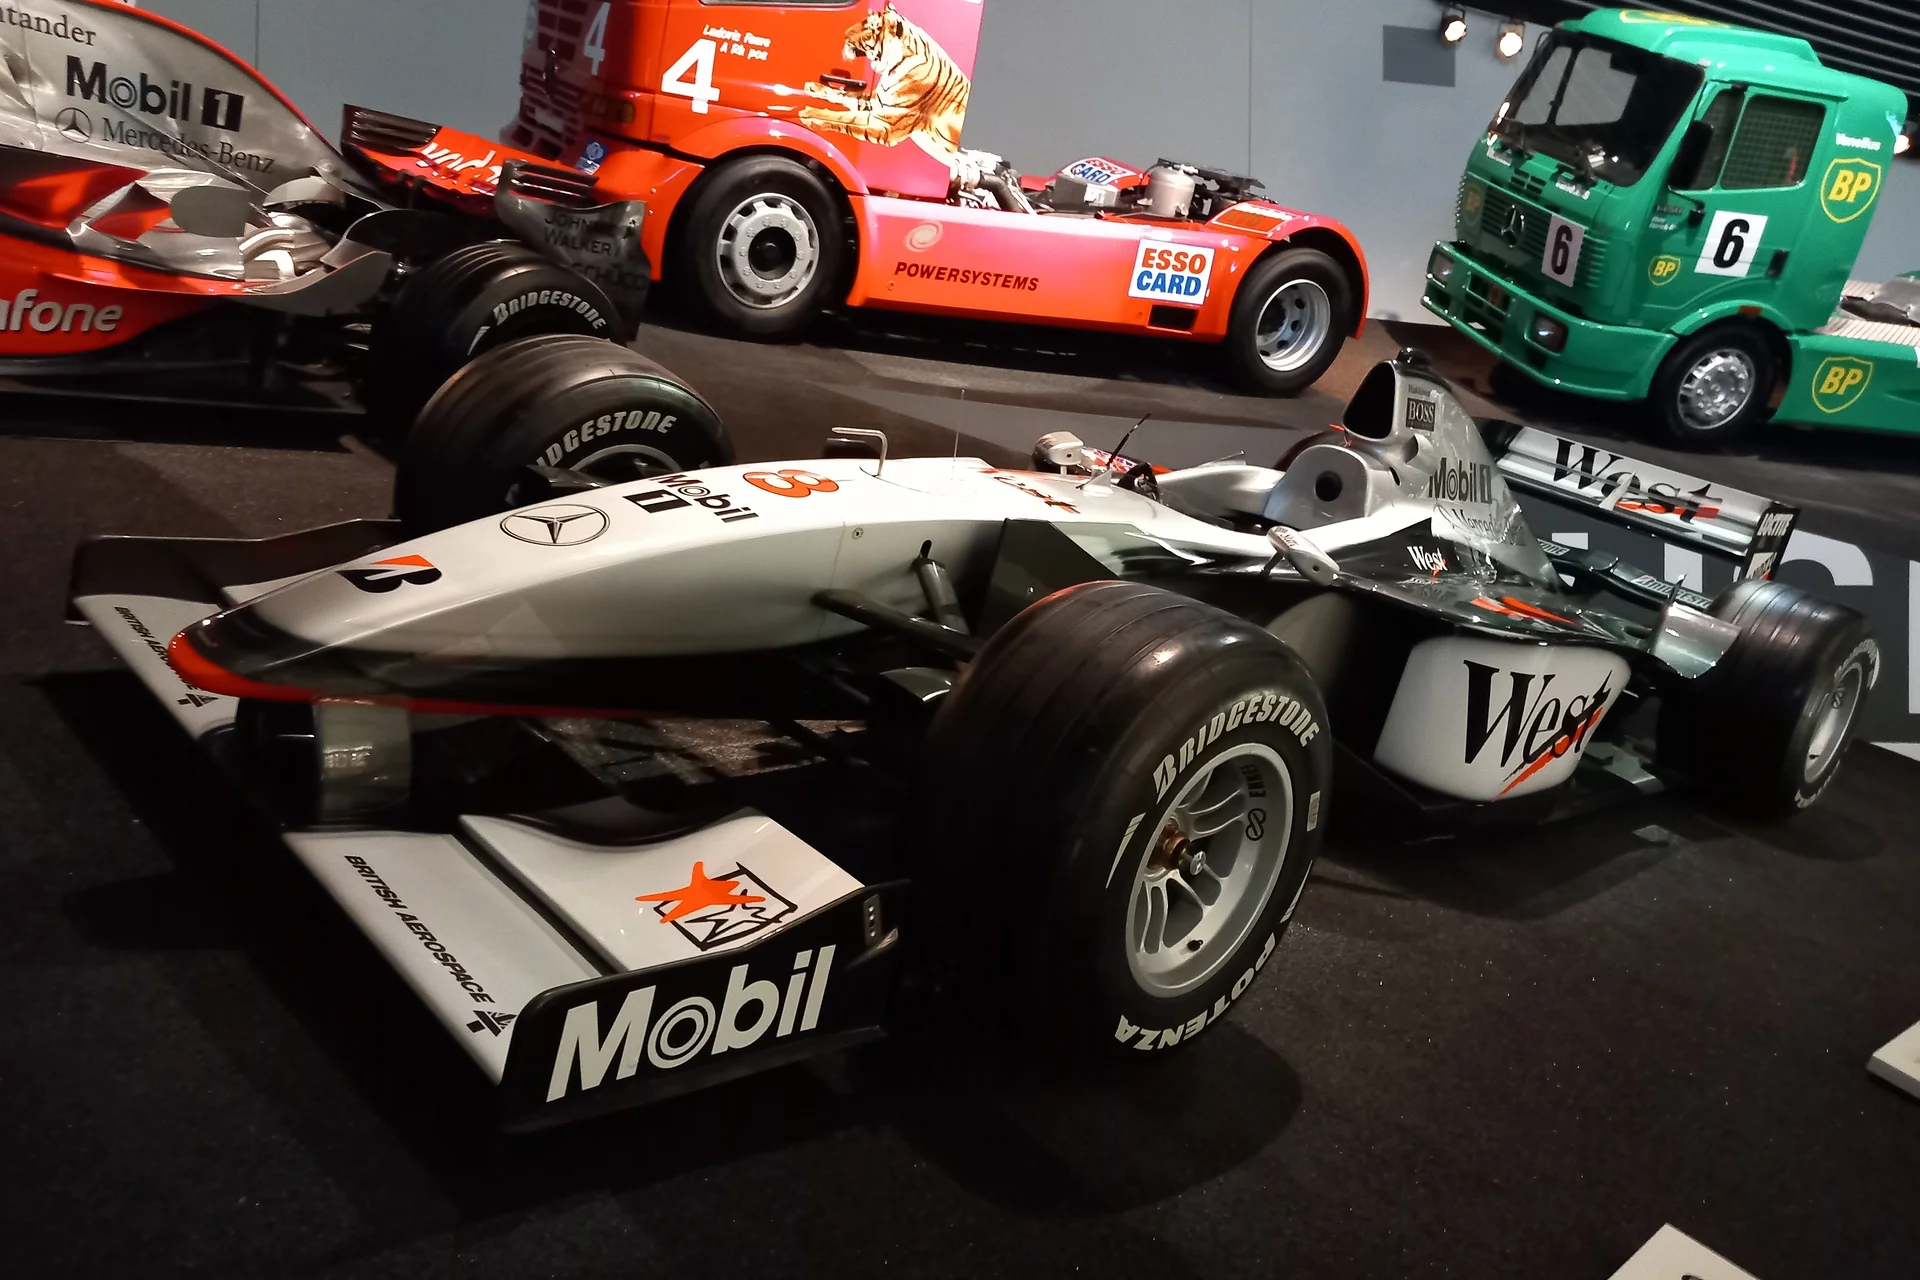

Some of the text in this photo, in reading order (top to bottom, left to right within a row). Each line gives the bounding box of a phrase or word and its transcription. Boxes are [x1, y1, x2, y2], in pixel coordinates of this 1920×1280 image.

[583, 2, 611, 76] 4
[66, 55, 191, 121] Mobil
[661, 38, 720, 115] 4
[103, 117, 275, 173] Mercedes-Benz
[1828, 169, 1872, 203] BP
[1142, 248, 1206, 274] ESSO
[1551, 224, 1573, 276] 6
[1653, 260, 1676, 277] BP
[1713, 218, 1750, 269] 6
[894, 261, 1040, 292] POWERSYSTEMS
[1137, 270, 1202, 296] CARD
[493, 290, 607, 331] BRIDGESTONE
[1819, 366, 1863, 395] BP
[1408, 400, 1434, 424] BOSS
[649, 474, 759, 523] Mobil
[743, 469, 839, 498] 8
[1429, 457, 1477, 503] Mobil
[1553, 438, 1723, 525] West
[1407, 546, 1448, 571] West
[1463, 660, 1613, 771] West
[1153, 694, 1320, 805] BRIDGESTONE
[344, 855, 496, 1004] BRITISH AEROSPACE
[1115, 932, 1277, 1051] POTENZA
[546, 944, 837, 1103] Mobil
